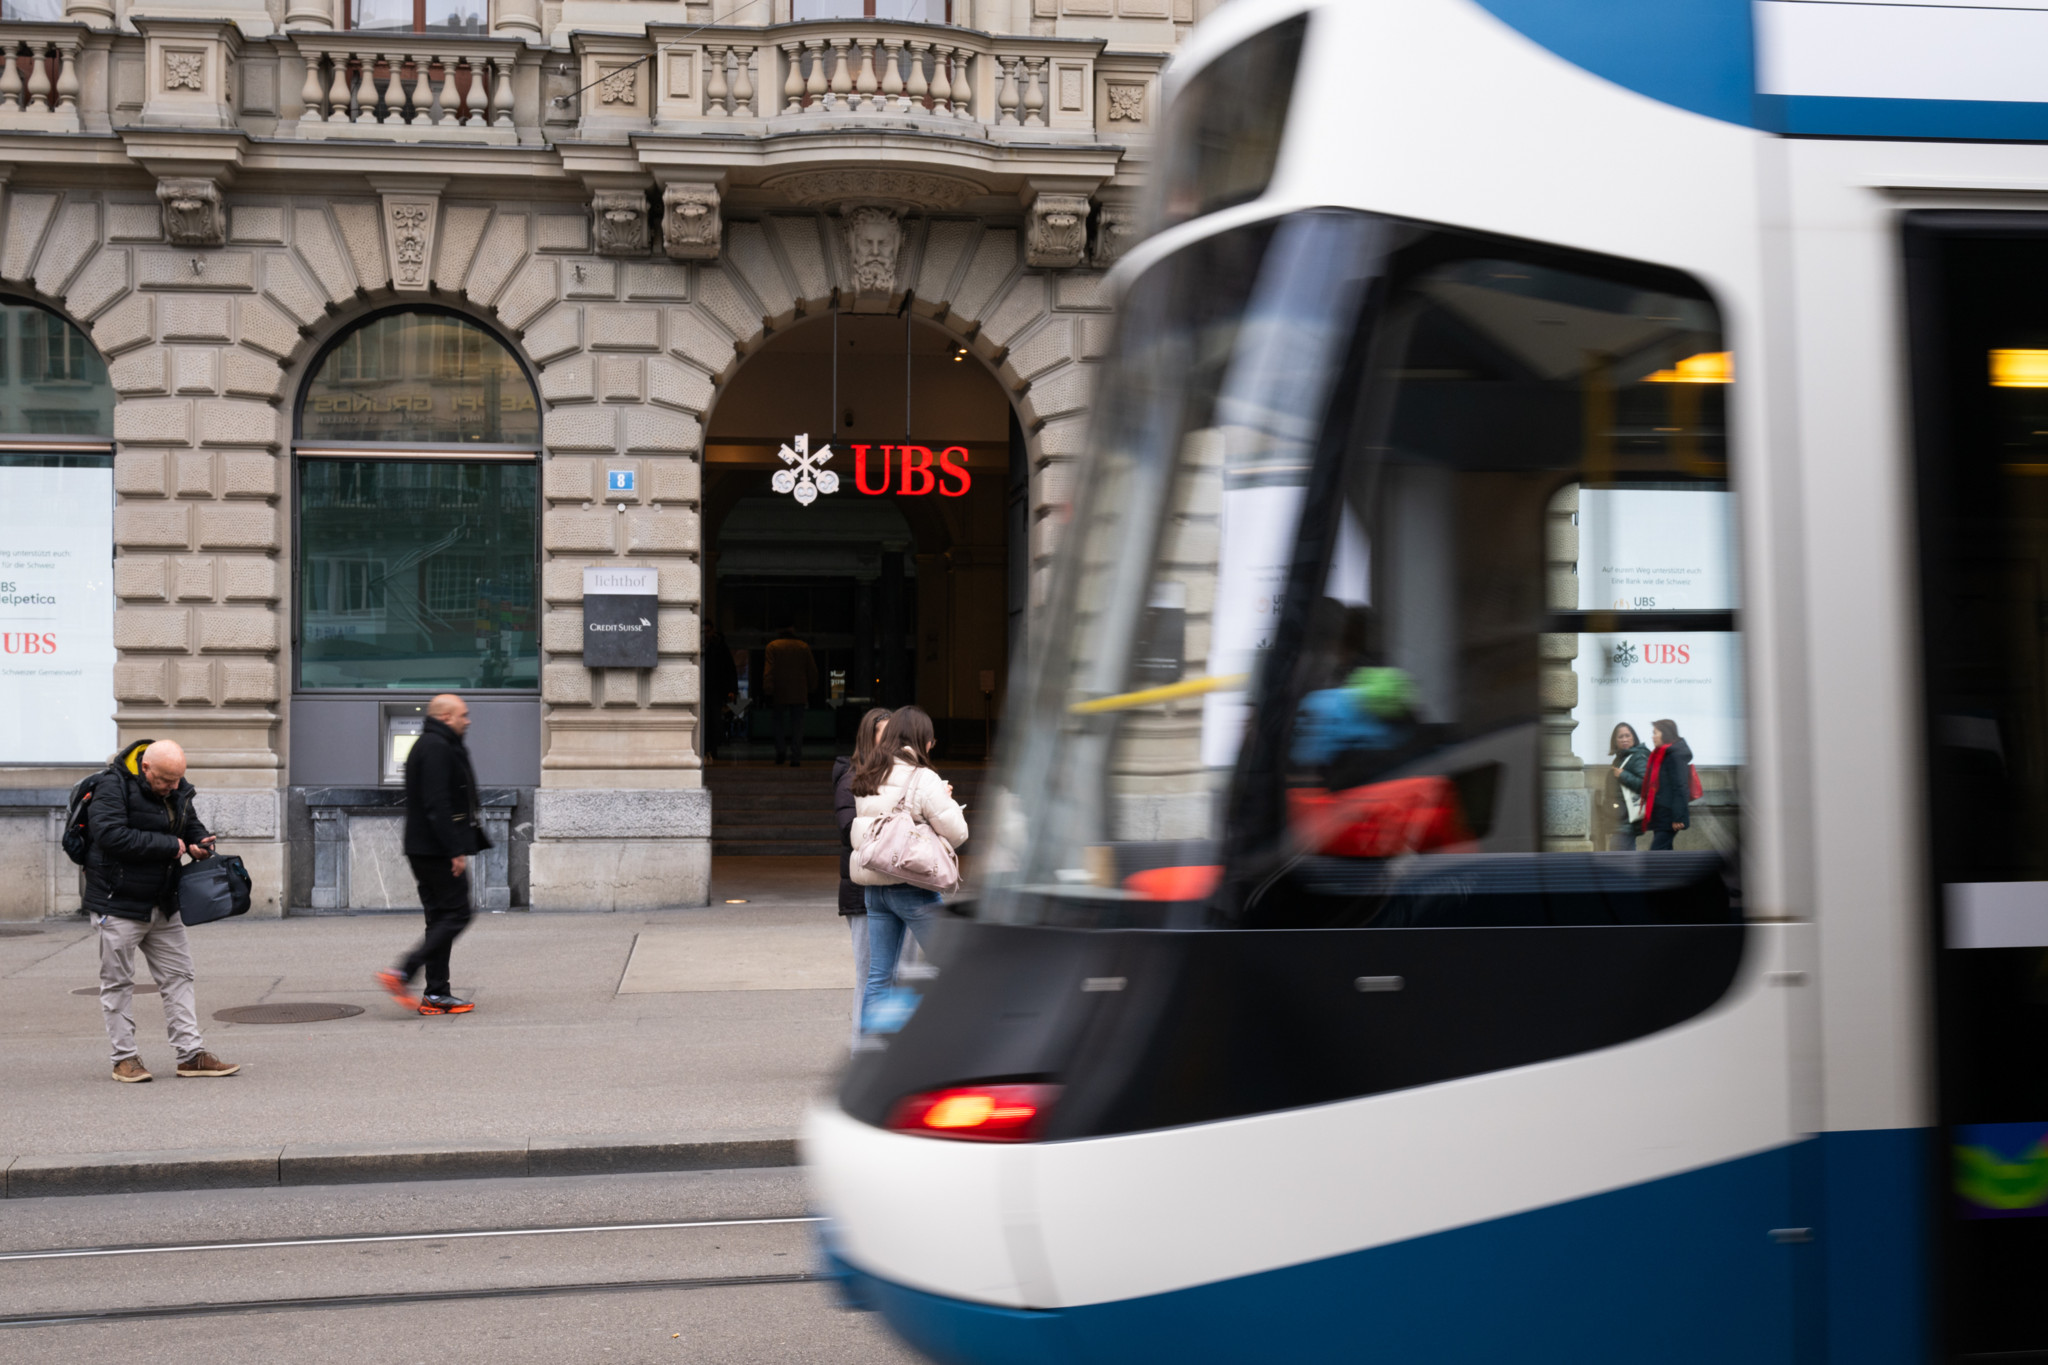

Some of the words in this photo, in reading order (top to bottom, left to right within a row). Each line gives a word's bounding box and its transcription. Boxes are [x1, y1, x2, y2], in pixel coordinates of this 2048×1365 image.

[851, 444, 971, 497] UBS
[616, 474, 626, 488] 8
[27, 561, 55, 569] Schweiz
[1636, 566, 1650, 575] Weg
[595, 575, 647, 587] lichthof
[0, 594, 56, 606] elpetica
[1634, 597, 1655, 606] UBS
[589, 623, 617, 632] CREDIT
[619, 623, 643, 632] SUISSE
[3, 633, 57, 654] UBS
[1643, 644, 1690, 664] UBS
